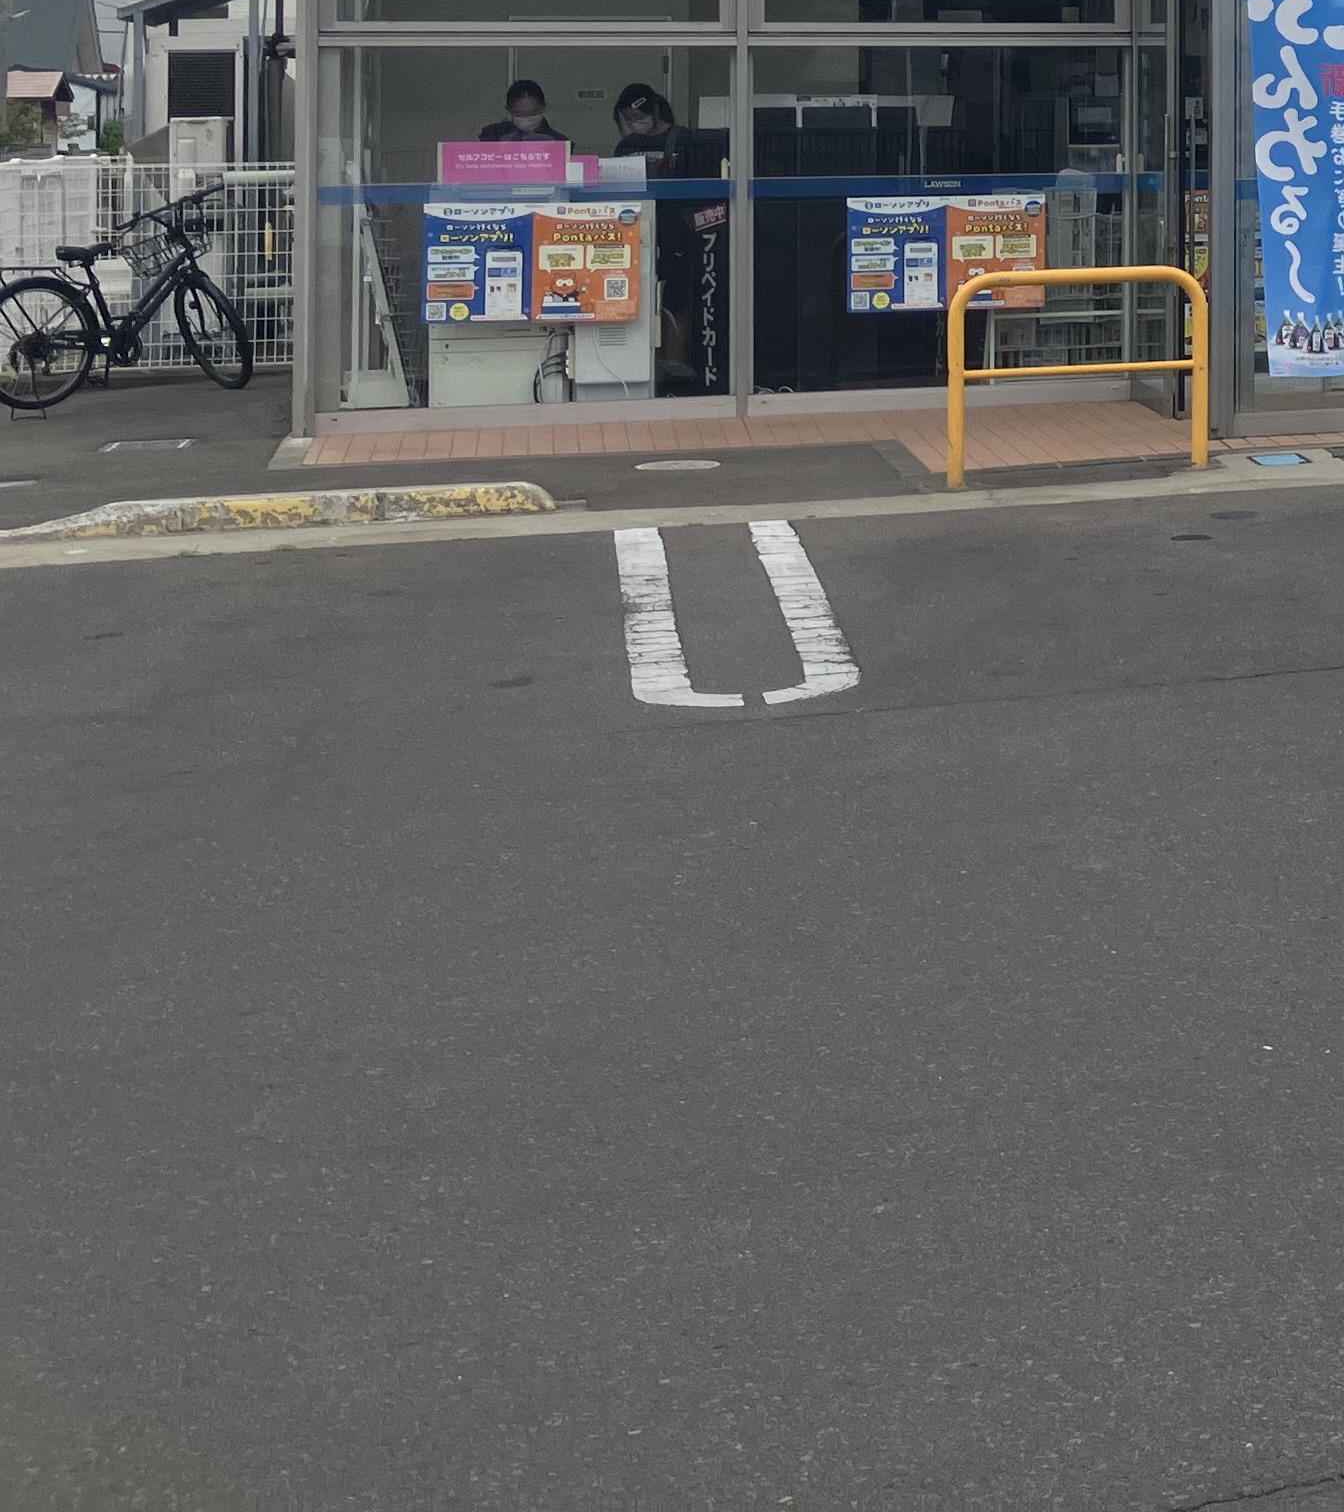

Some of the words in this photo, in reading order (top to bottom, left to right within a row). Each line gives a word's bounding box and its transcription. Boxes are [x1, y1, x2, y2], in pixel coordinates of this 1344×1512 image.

[924, 180, 962, 188] LAWSON
[454, 206, 515, 216] ローソンアプリ
[694, 205, 725, 226] 販売中
